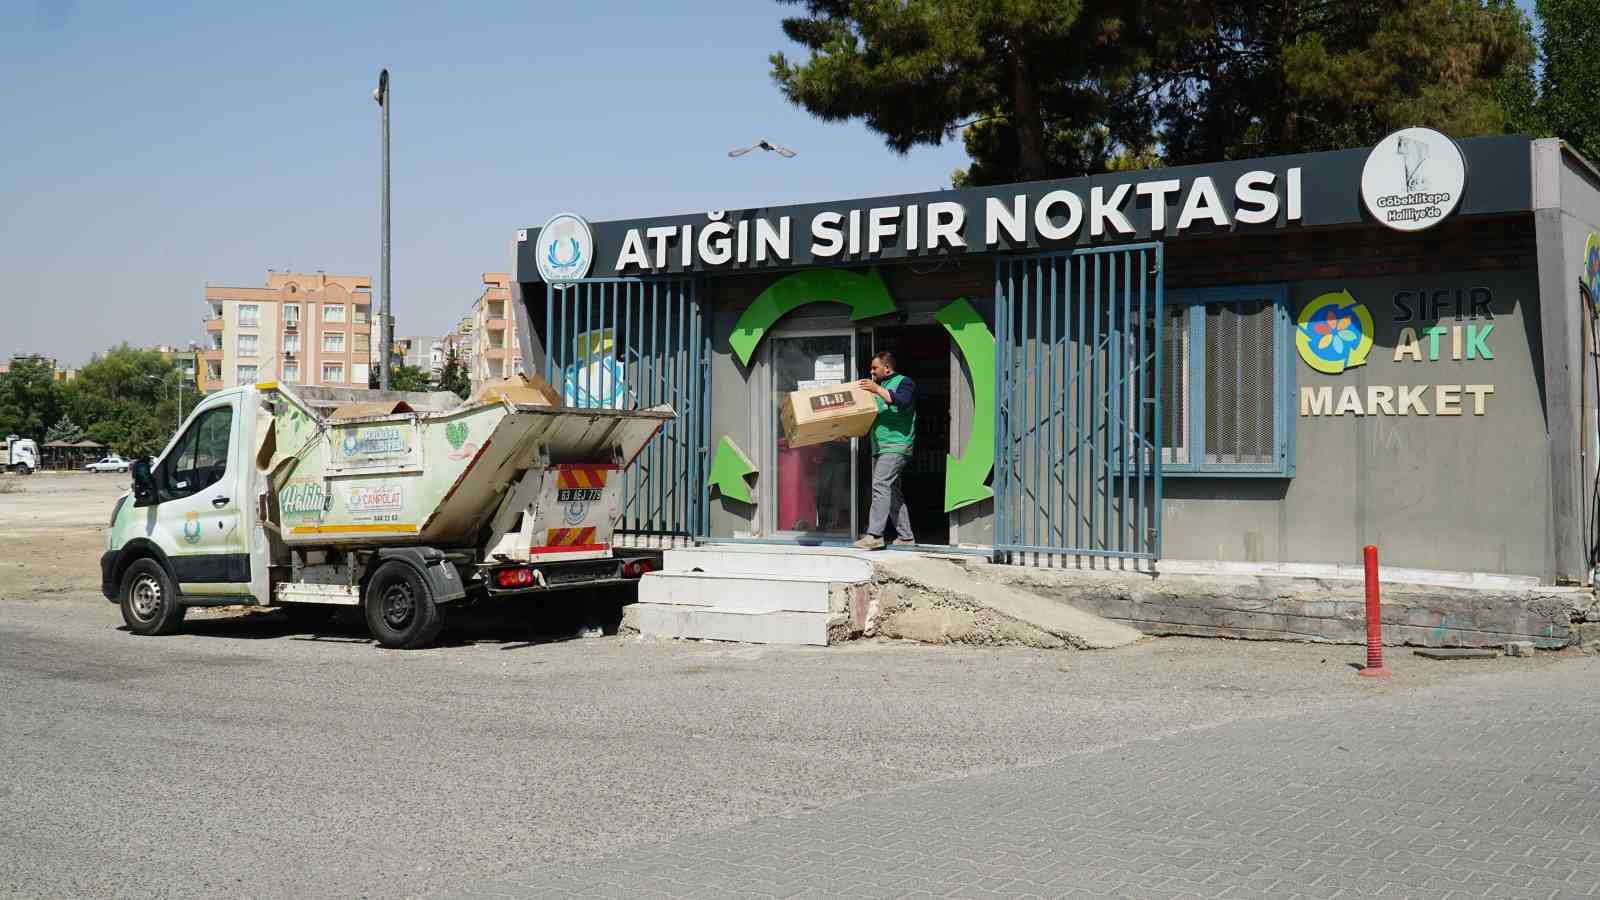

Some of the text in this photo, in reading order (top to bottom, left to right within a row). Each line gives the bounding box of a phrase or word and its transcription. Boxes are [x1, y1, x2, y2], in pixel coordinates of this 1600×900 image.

[1377, 193, 1450, 207] Göbeklitepe
[615, 167, 1302, 271] ATIĞIN SIFIR NOKTASI
[1394, 287, 1495, 321] SIFIR
[1393, 324, 1496, 362] ATIK
[1300, 384, 1495, 416] MARKET
